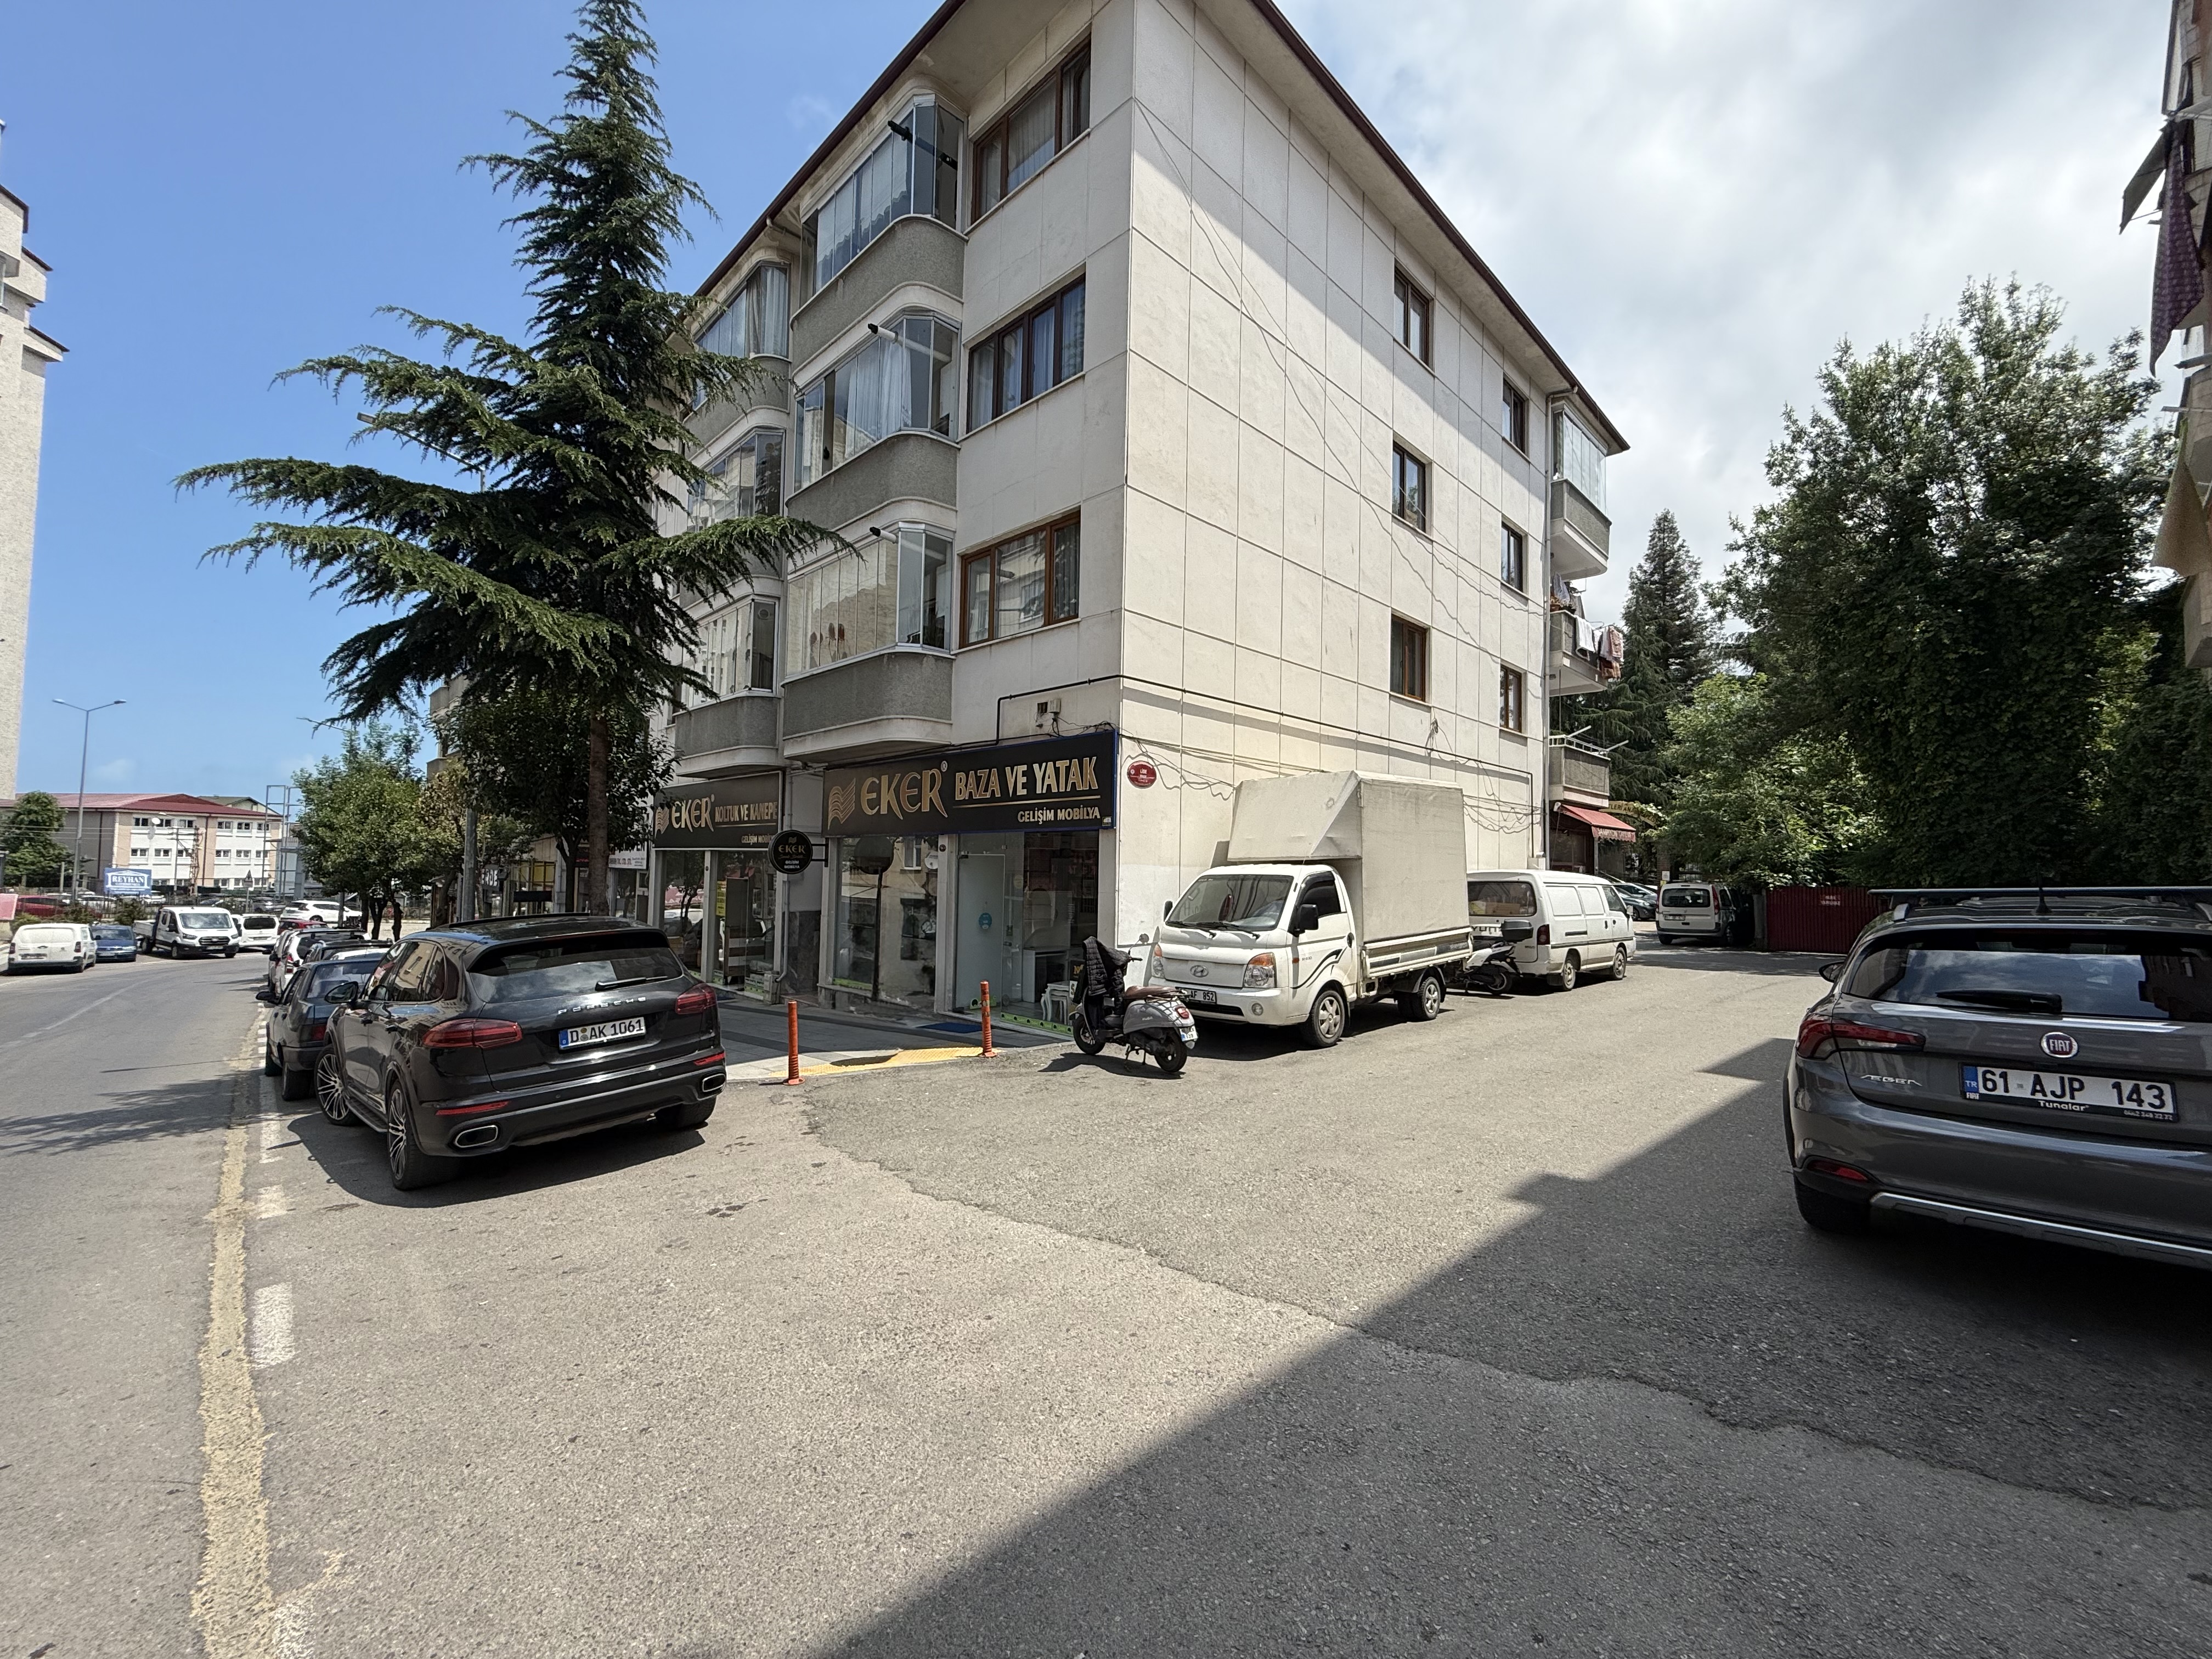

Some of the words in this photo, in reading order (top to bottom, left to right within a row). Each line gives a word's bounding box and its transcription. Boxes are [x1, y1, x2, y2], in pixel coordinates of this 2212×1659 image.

[860, 768, 948, 818] EKER
[955, 768, 1001, 800] BAZA
[1005, 765, 1028, 797] VE
[1032, 756, 1099, 794] YATAK
[671, 797, 714, 832] EKER
[715, 804, 740, 822] KOLTUK
[740, 804, 749, 821] VE
[749, 802, 778, 820] KANEPE
[1017, 807, 1054, 825] GELİŞİM
[1057, 804, 1101, 820] MOBİLYA
[778, 845, 806, 854] EKER
[558, 996, 646, 1014] PORSCHE
[1203, 991, 1214, 1001] 852
[569, 1029, 579, 1043] D
[589, 1025, 607, 1040] AK
[610, 1019, 644, 1036] 1061
[2049, 1039, 2070, 1052] FIAT
[1965, 1080, 1978, 1088] TR
[1981, 1069, 2010, 1093] 61
[2030, 1074, 2085, 1100] AJP
[2111, 1081, 2166, 1109] 143
[2037, 1100, 2086, 1111] Tunalar
